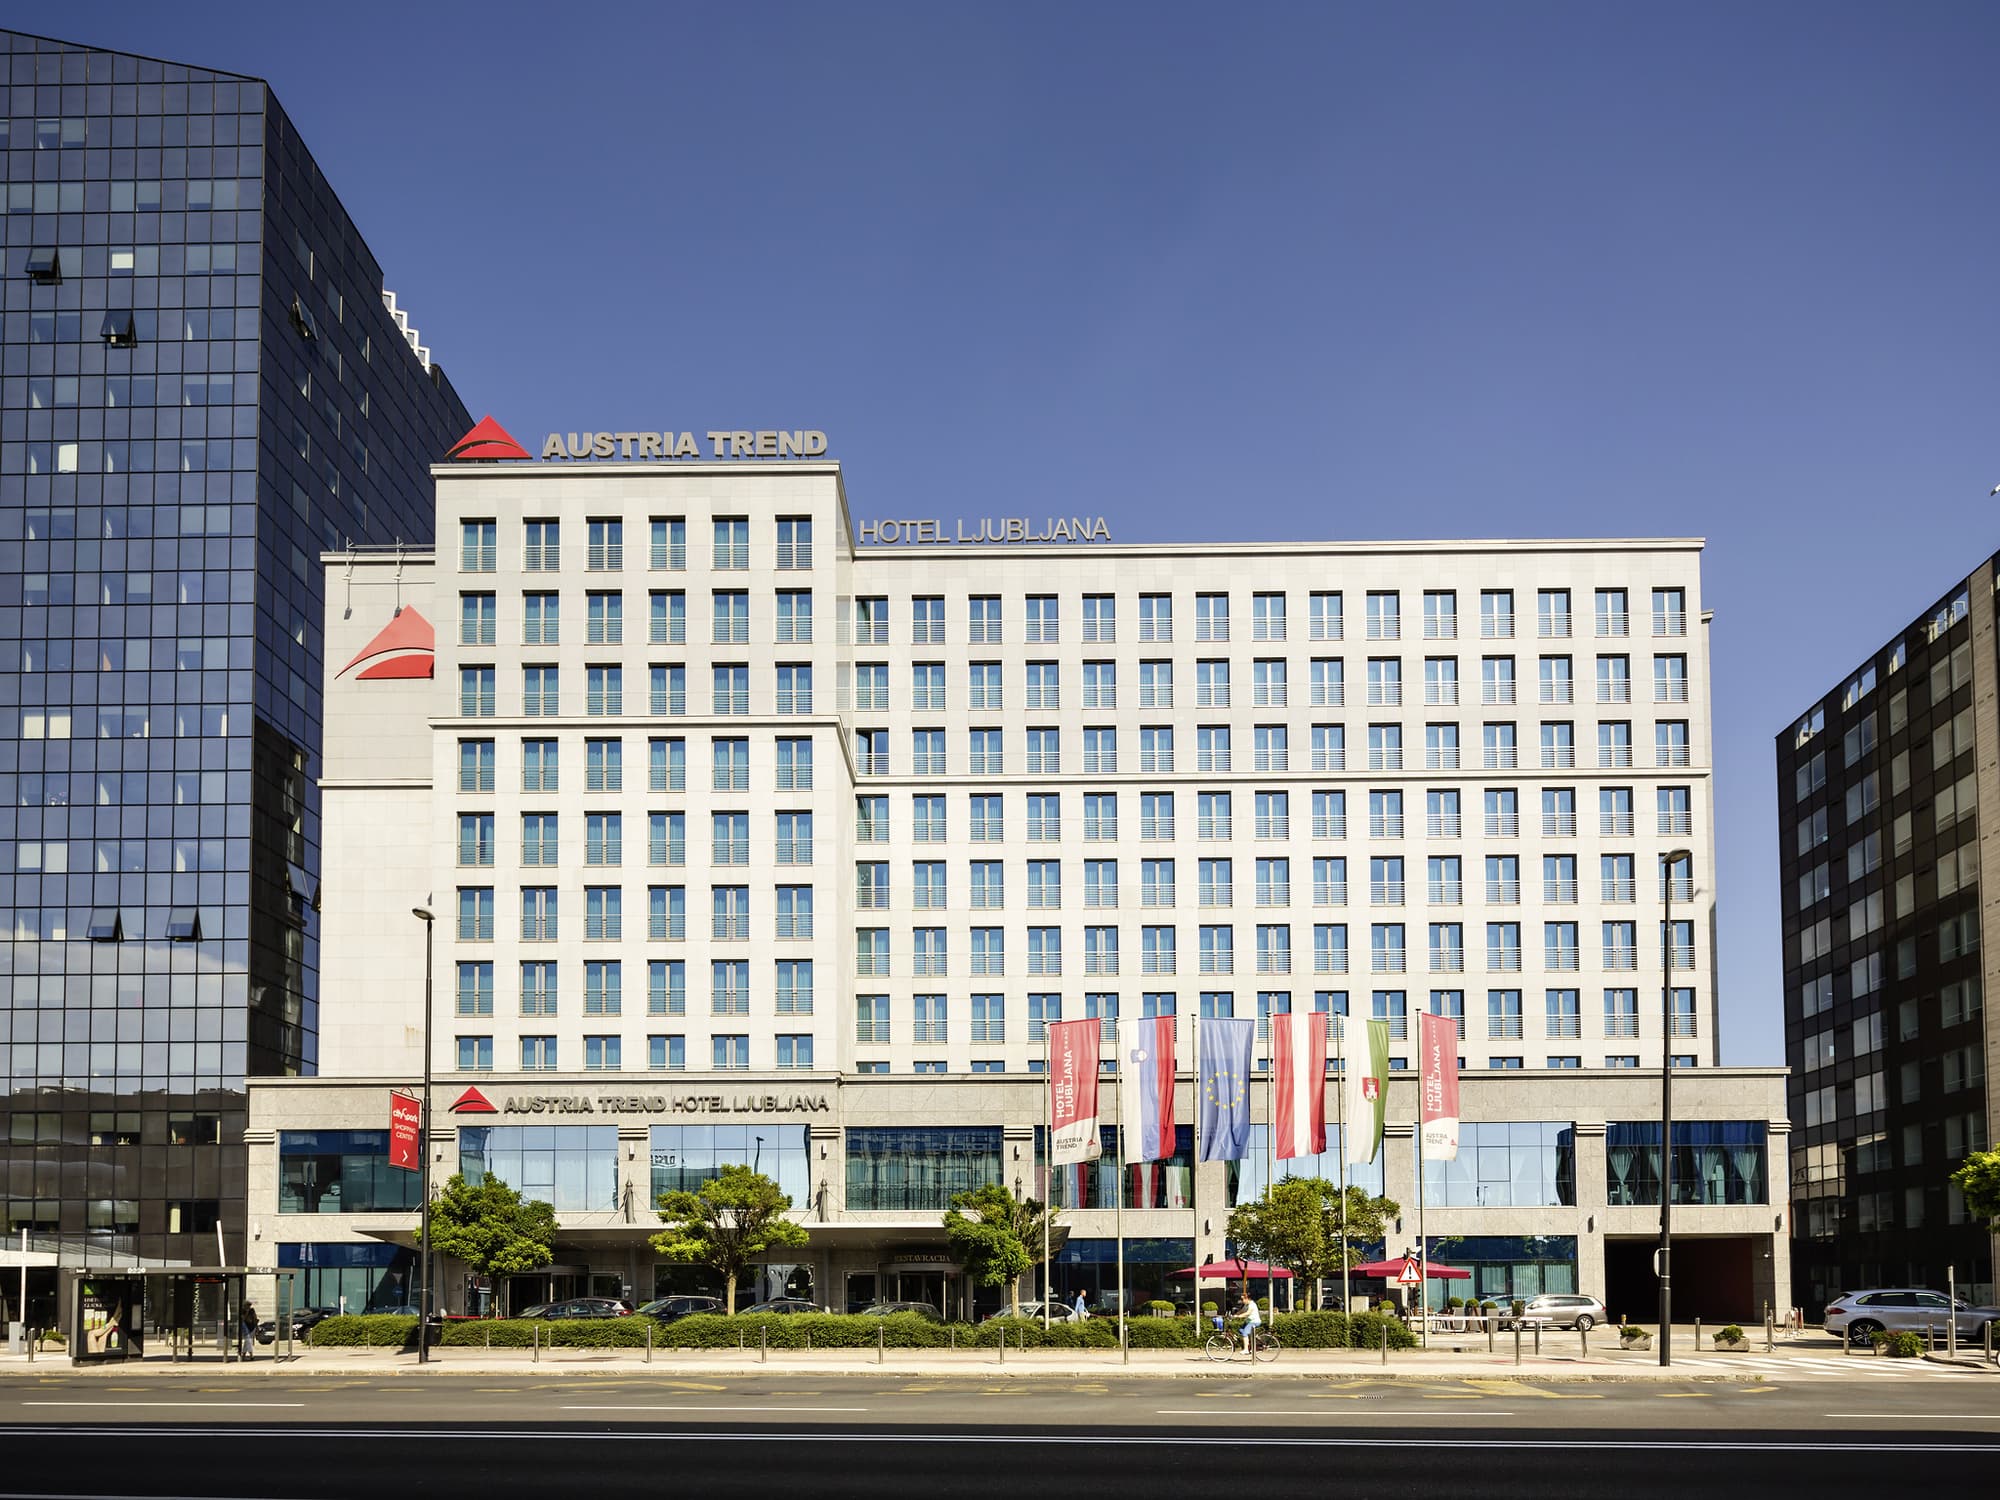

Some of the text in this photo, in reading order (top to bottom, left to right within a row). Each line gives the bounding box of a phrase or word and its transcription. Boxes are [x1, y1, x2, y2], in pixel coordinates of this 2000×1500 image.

[542, 431, 828, 459] AUSTRIA TREND
[859, 517, 1111, 543] HOTEL LJUBLJANA
[1064, 1050, 1074, 1117] LJUBLJANA
[1426, 1073, 1434, 1111] HOTEL
[1433, 1045, 1442, 1112] LJUBLJANA
[504, 1095, 830, 1114] AUSTRIA TREND HOTEL LJUBLJANA
[1056, 1080, 1065, 1118] HOTEL
[1056, 1136, 1083, 1144] AUSTRIA
